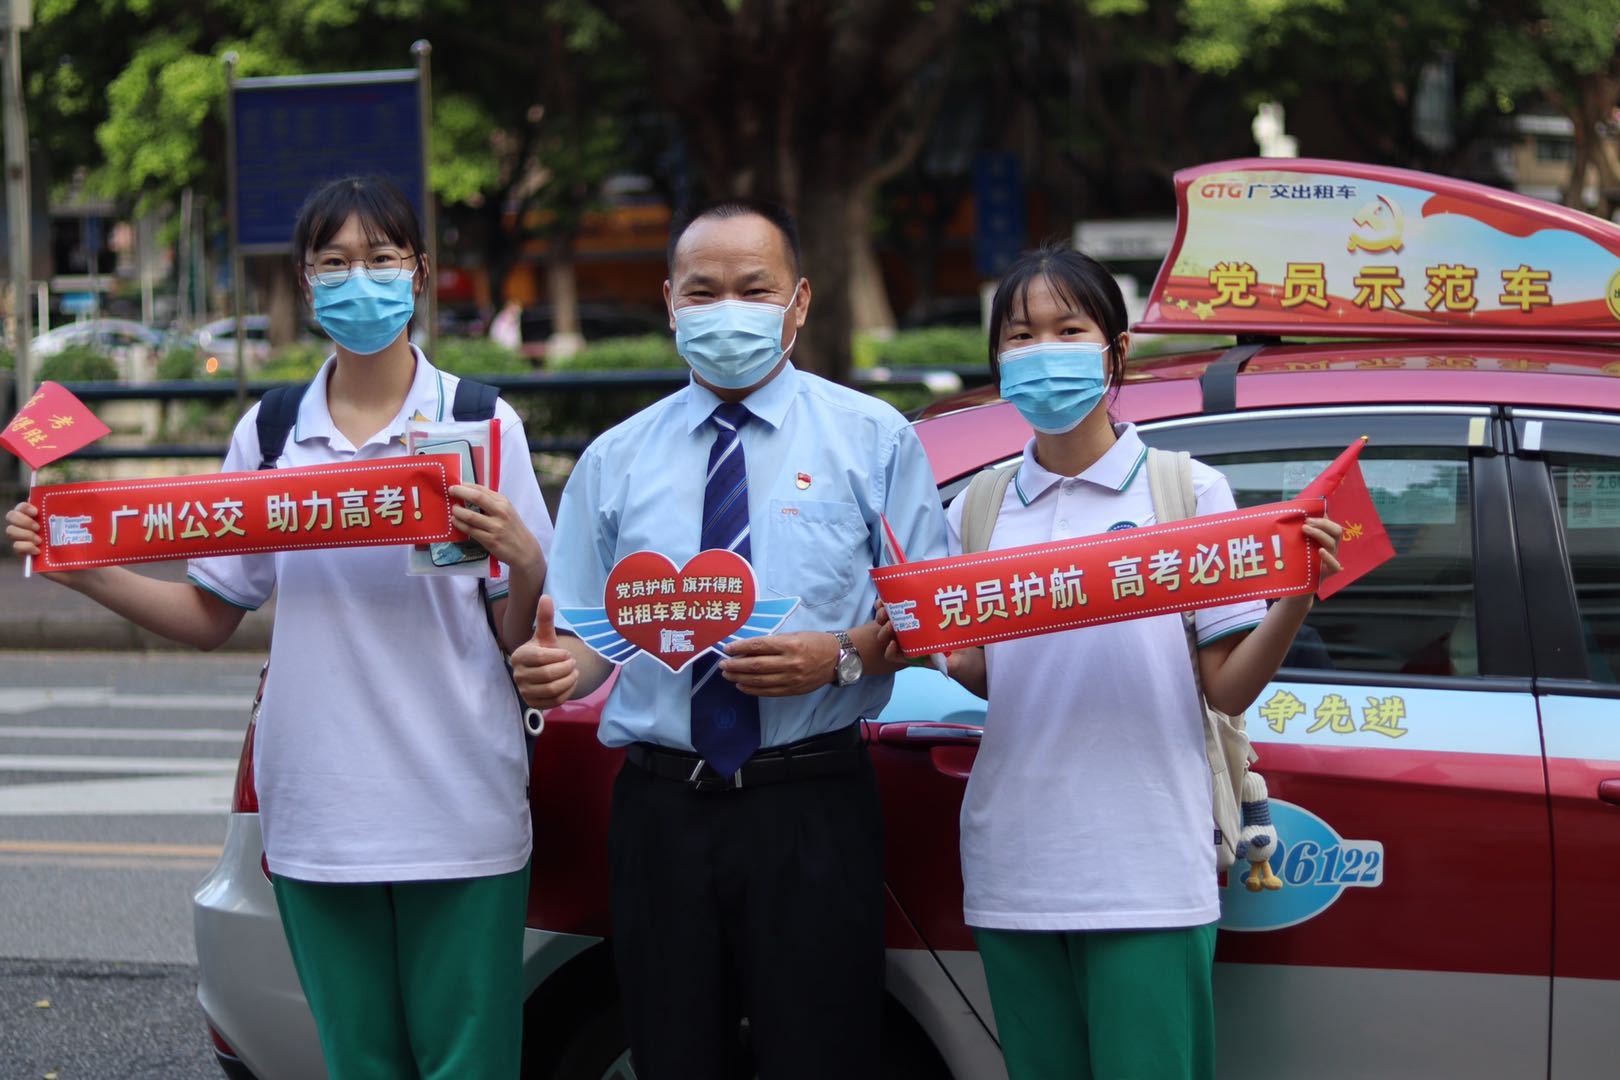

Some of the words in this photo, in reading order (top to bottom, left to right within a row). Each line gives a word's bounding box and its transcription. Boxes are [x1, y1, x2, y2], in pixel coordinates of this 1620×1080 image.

[1200, 183, 1242, 199] GTG
[1247, 184, 1357, 200] 广交出租车
[1208, 261, 1553, 312] 党员示范车
[109, 497, 246, 545] 广州公交
[267, 486, 422, 532] 助力高考!
[615, 577, 676, 600] 党员护航
[682, 576, 743, 594] 旗开得胜
[933, 565, 1088, 629] 党员护航
[1107, 533, 1285, 601] 高考必胜!
[617, 600, 742, 626] 出租车爱心送考
[1258, 688, 1409, 740] 争先进
